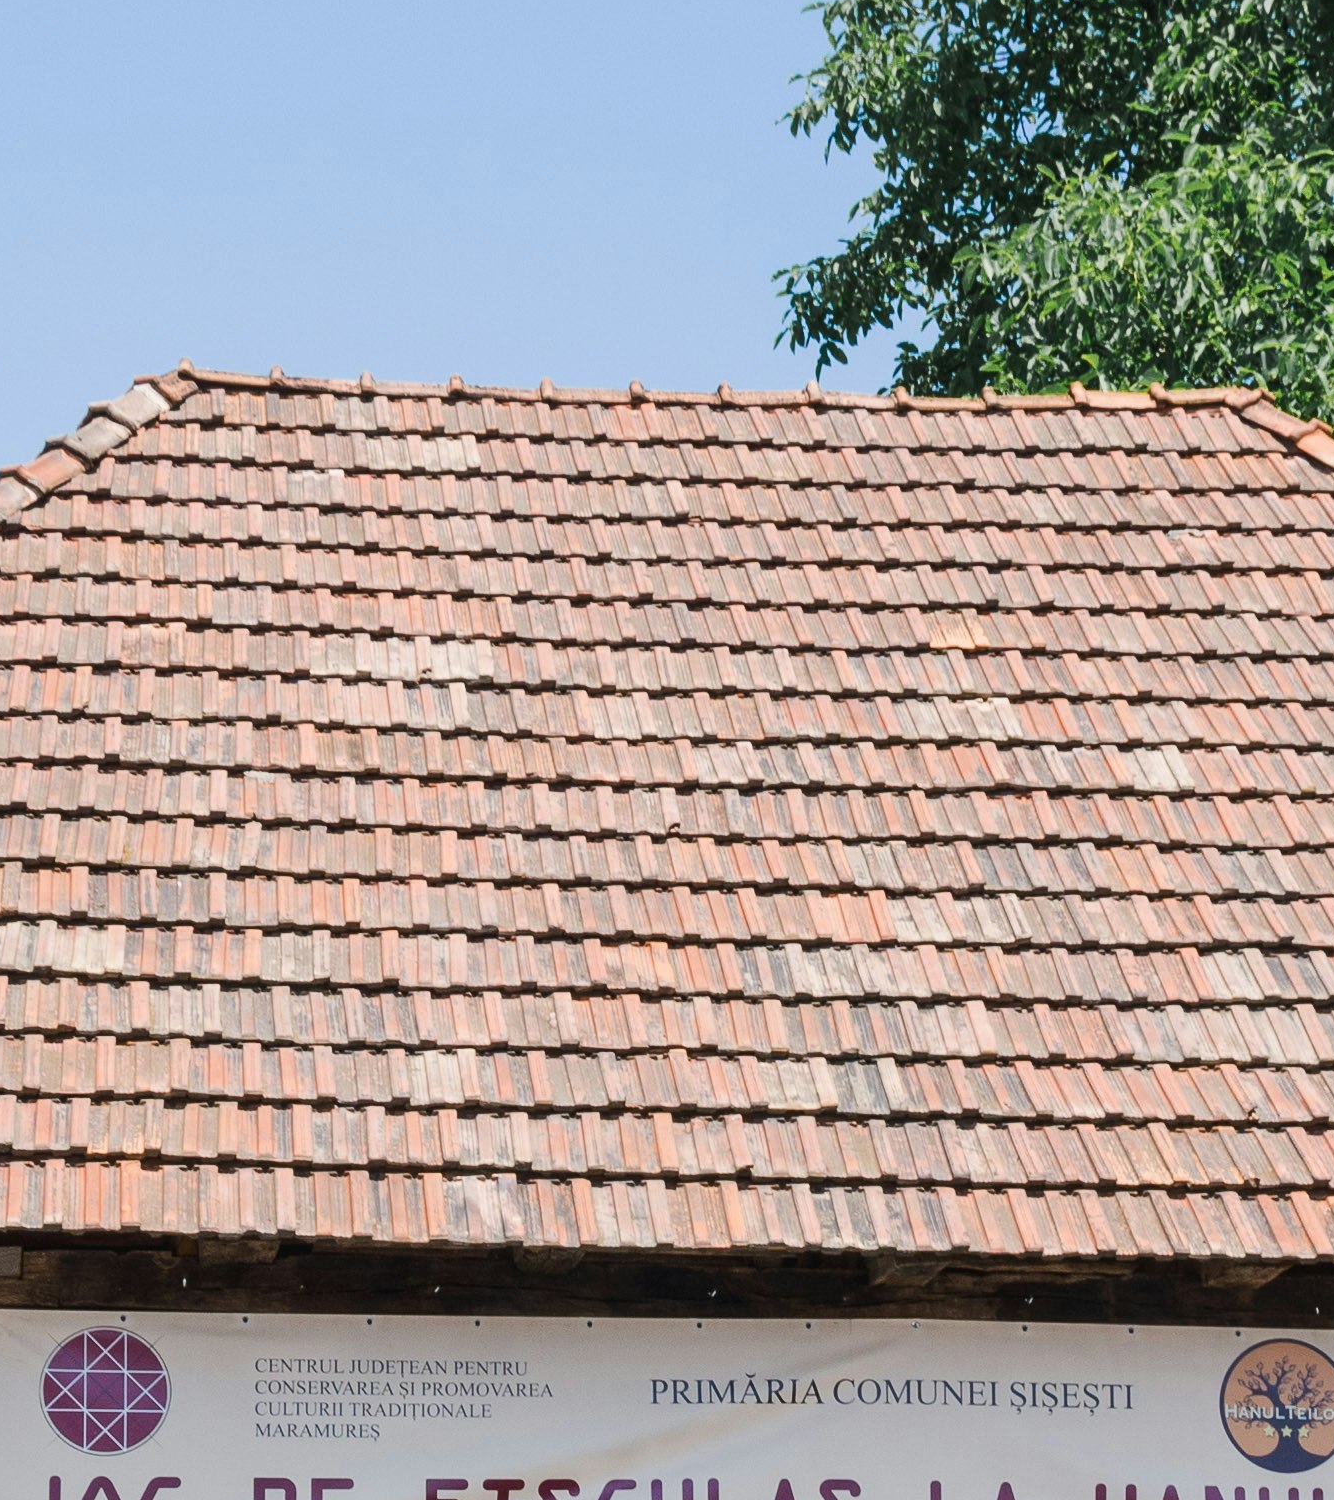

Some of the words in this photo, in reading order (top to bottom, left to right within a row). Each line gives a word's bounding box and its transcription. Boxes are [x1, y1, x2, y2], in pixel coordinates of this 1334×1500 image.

[254, 1358, 345, 1374] CENTRUL
[349, 1359, 448, 1378] JUDEȚEAN
[454, 1360, 529, 1376] PENTRU
[254, 1380, 395, 1396] CONSERVAREA
[399, 1381, 416, 1399] ȘI
[421, 1381, 554, 1398] PROMOVAREA
[650, 1372, 824, 1405] PRIMĂRIA
[833, 1378, 998, 1407] COMUNEI
[1010, 1381, 1134, 1416] ȘIȘEȘTI
[254, 1401, 344, 1417] CULTURII
[349, 1402, 492, 1421] TRADIȚIONALE
[254, 1423, 380, 1441] MARAMUREȘ
